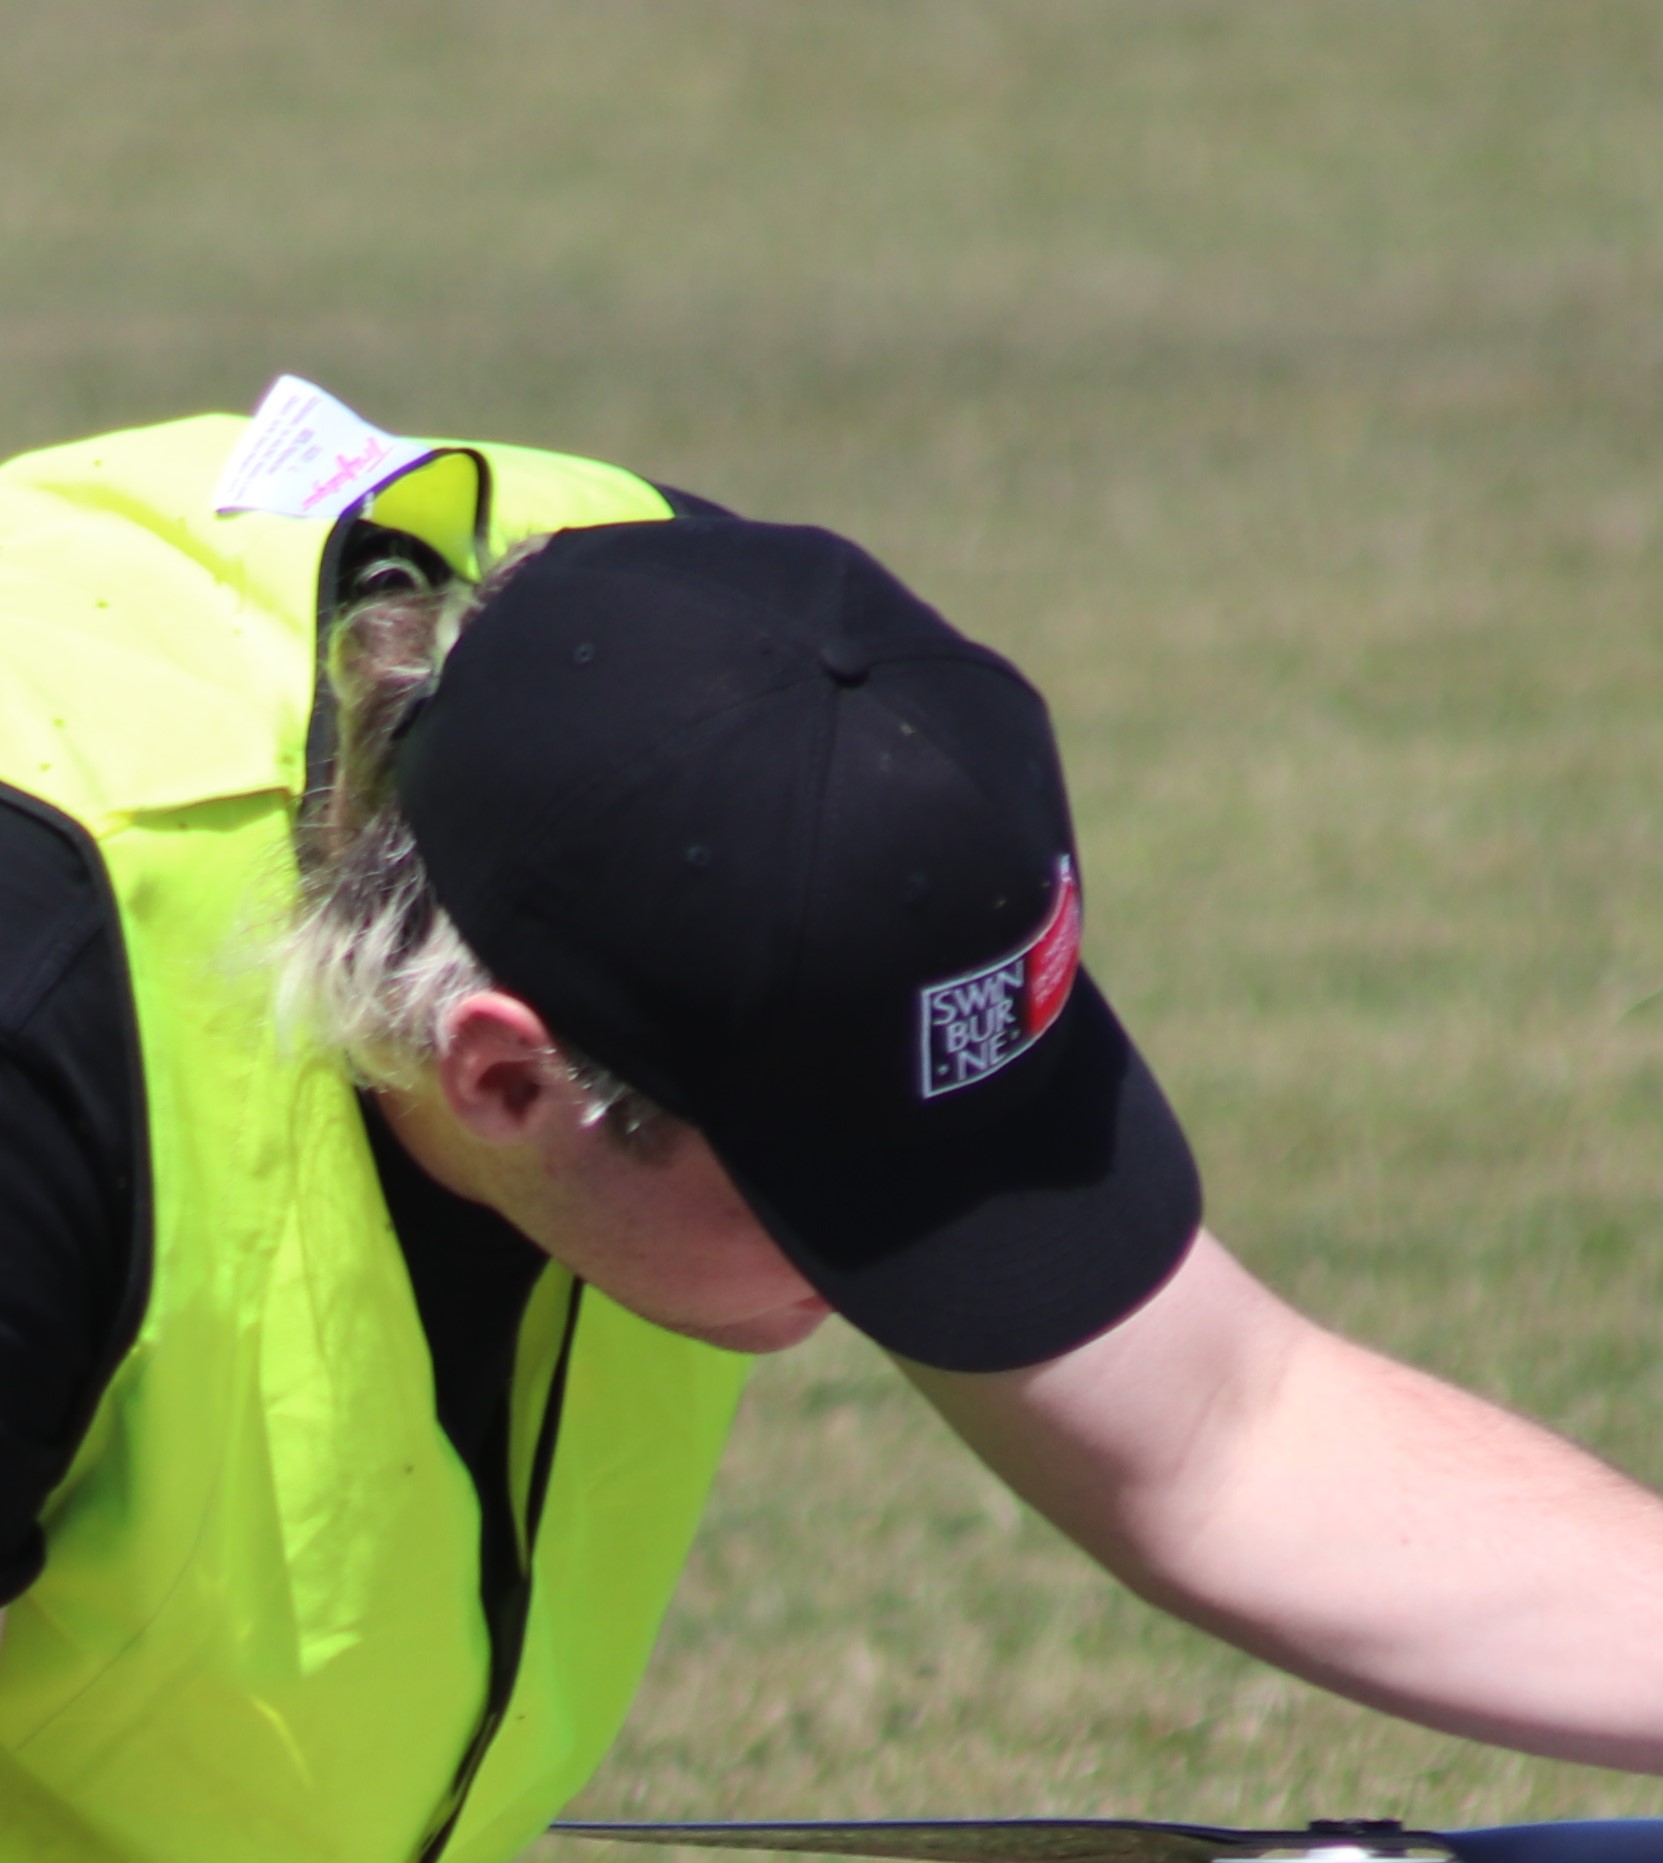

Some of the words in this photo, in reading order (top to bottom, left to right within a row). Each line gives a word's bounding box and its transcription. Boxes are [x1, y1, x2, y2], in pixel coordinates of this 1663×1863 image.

[932, 959, 1025, 1026] SWIN
[946, 997, 1017, 1055] BUR
[957, 1030, 1009, 1081] NE
